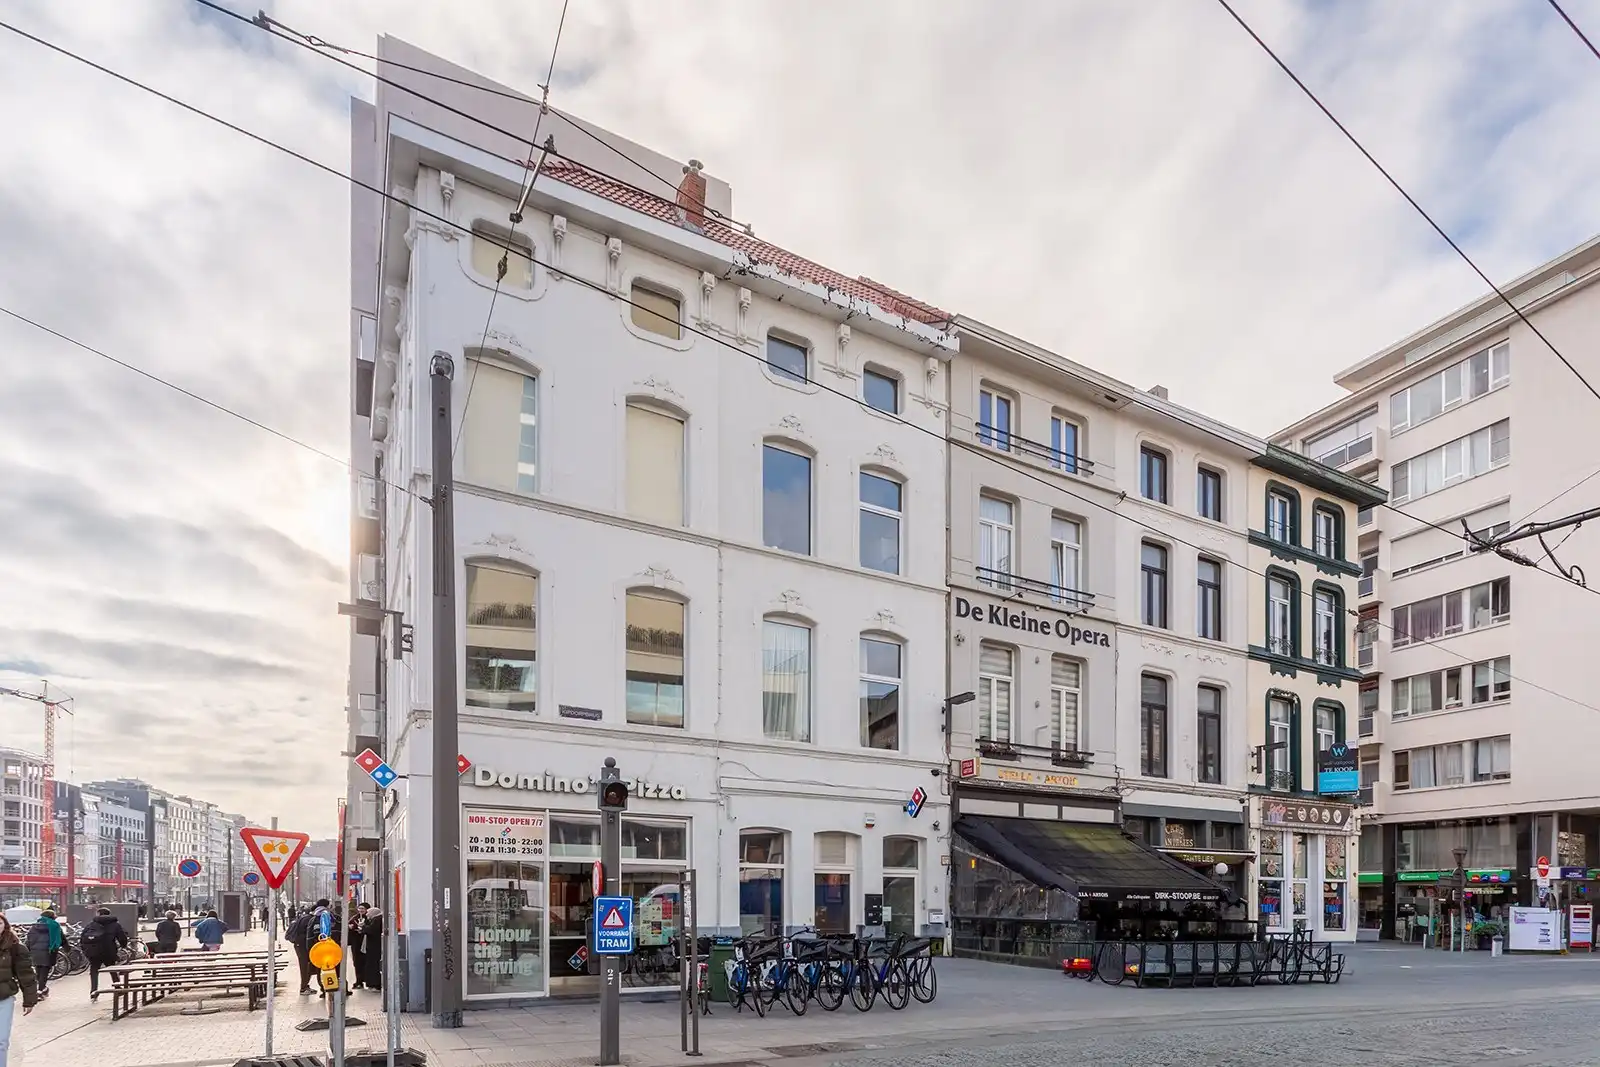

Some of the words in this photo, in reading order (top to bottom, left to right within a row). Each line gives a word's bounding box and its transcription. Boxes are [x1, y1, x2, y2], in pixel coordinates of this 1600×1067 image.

[955, 597, 983, 622] De
[988, 603, 1050, 636] Kleine
[1054, 618, 1110, 648] Opera
[474, 764, 598, 794] Domino'
[468, 815, 508, 825] NON-STOP
[510, 817, 530, 826] OPEN
[531, 818, 543, 826] 7/7
[469, 836, 479, 844] ZO
[469, 845, 479, 853] VR
[498, 846, 516, 854] 11:30
[521, 847, 543, 855] 23:00
[1154, 891, 1201, 900] DIRK-STOOP.BE
[474, 926, 532, 942] honour
[600, 938, 628, 948] TRAM
[473, 942, 502, 959] the
[473, 959, 533, 976] craving
[327, 977, 334, 986] B
